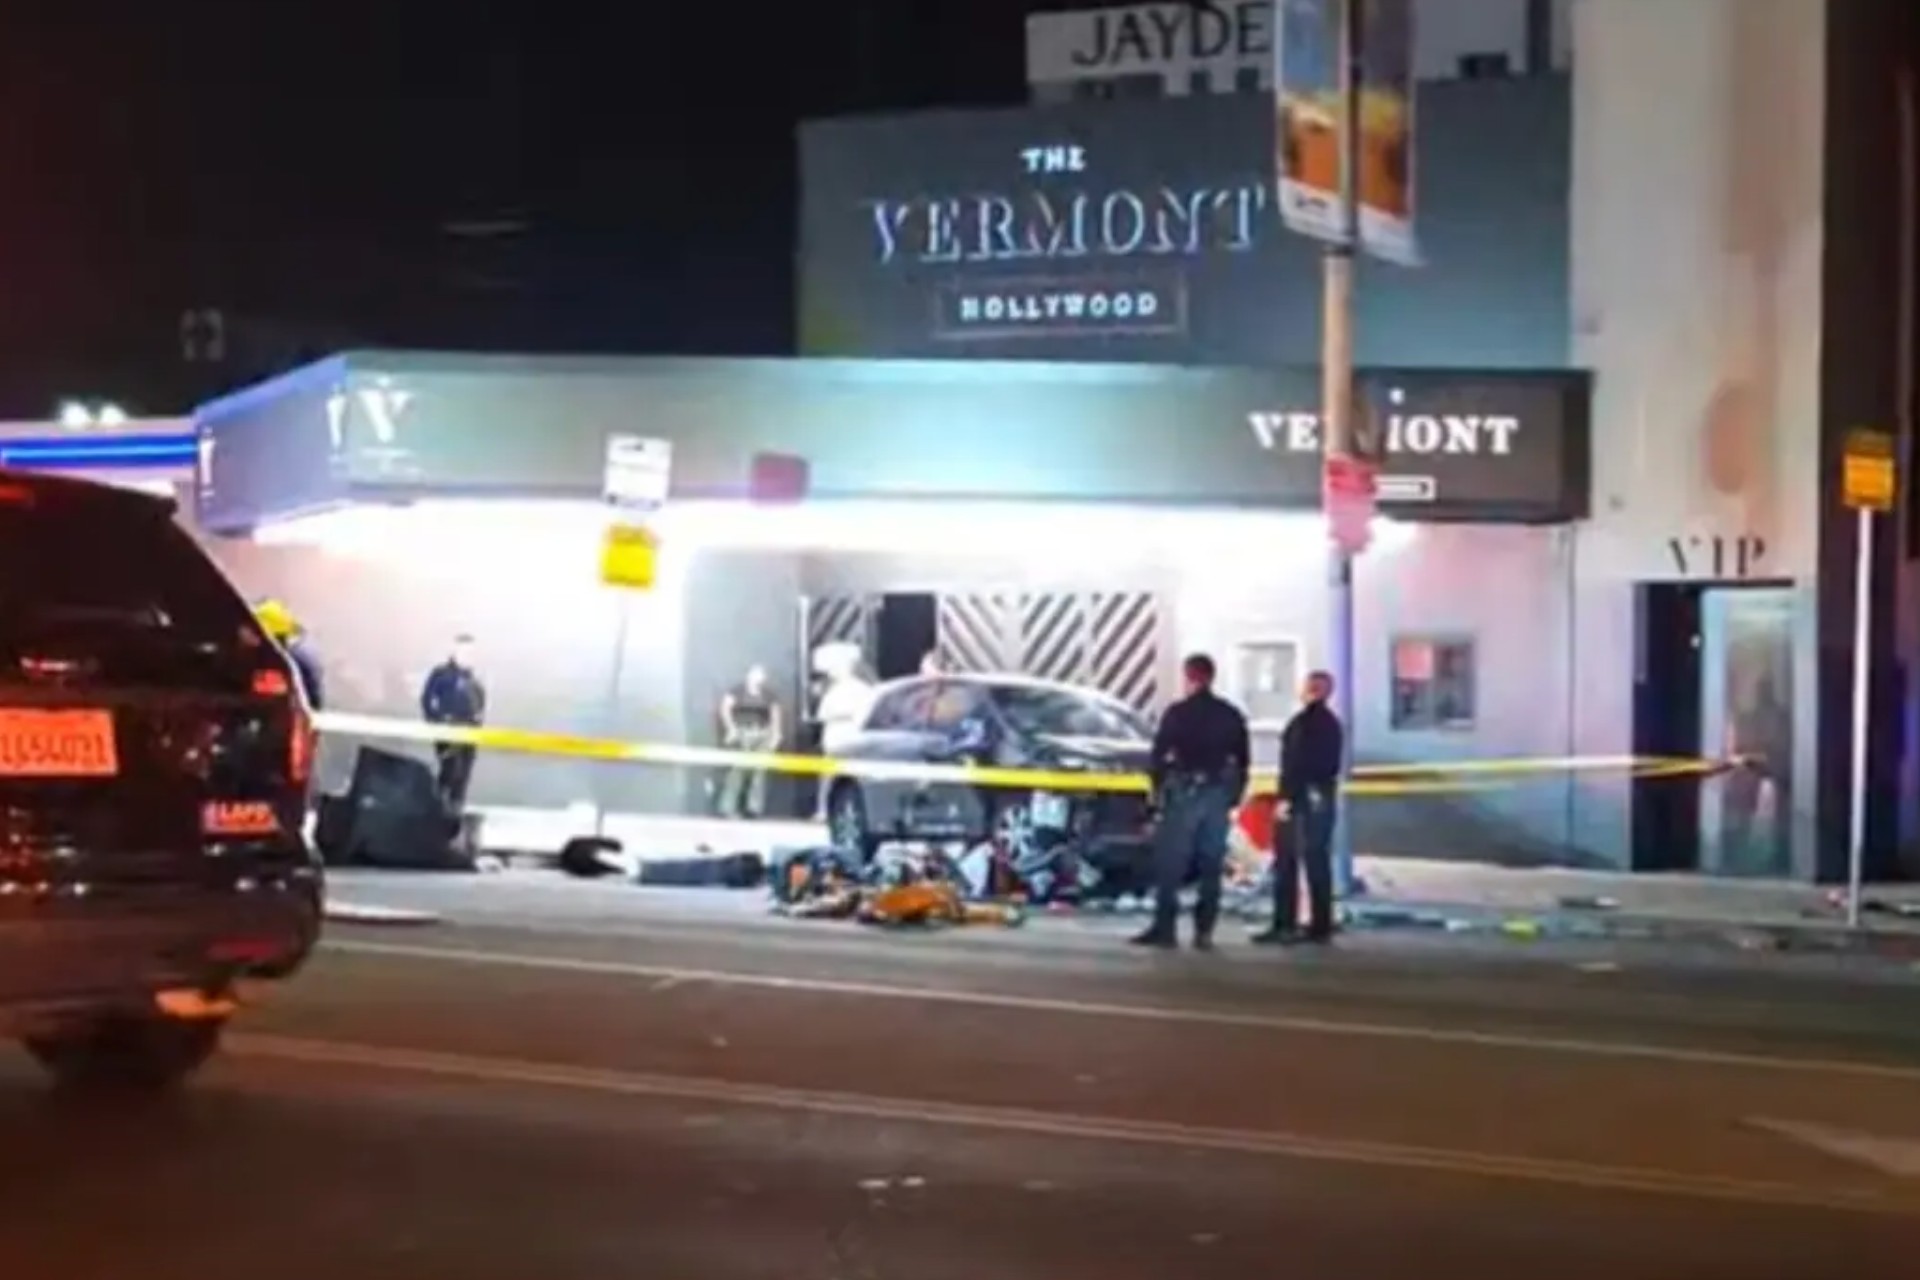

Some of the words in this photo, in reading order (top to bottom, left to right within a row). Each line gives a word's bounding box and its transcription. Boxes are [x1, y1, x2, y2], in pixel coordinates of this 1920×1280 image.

[1021, 146, 1086, 172] THE
[872, 184, 1266, 265] VERMONT
[960, 292, 1158, 322] HOLLYWOOD
[1669, 535, 1766, 577] VIP
